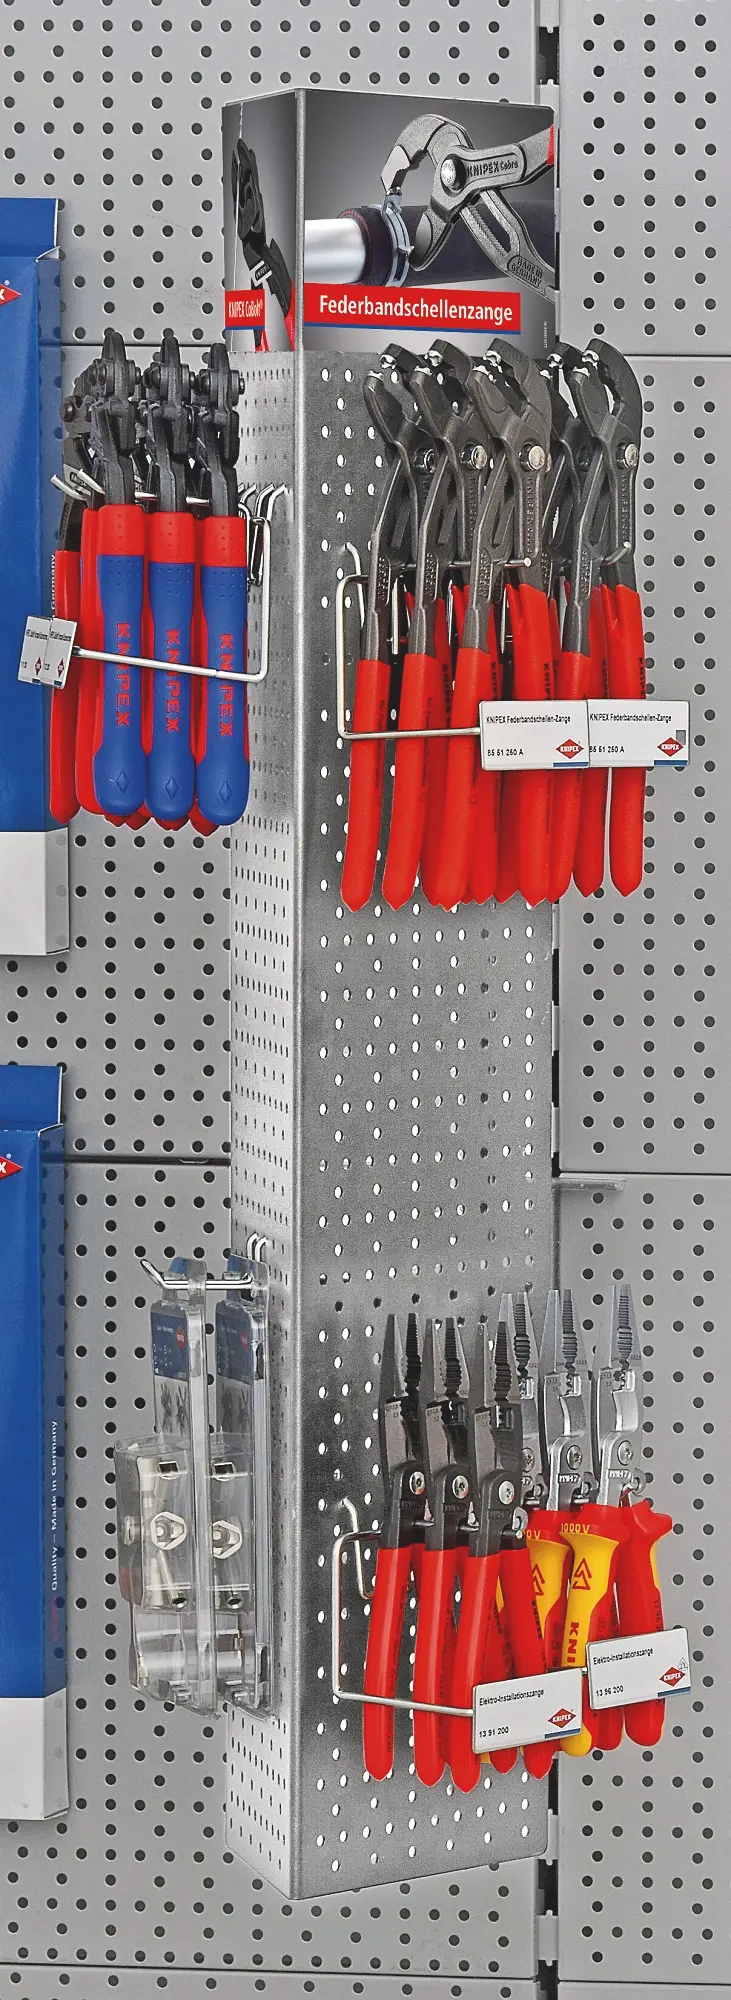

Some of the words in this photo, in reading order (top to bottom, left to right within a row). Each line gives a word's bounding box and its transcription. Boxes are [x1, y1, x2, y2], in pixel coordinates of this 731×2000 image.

[467, 160, 499, 177] KNIPEX
[500, 160, 519, 171] Cobra
[228, 300, 245, 318] KNIPEX
[319, 294, 513, 325] Federbandschellenzange
[117, 622, 130, 727] KNIPEX
[167, 629, 180, 732] KNIPEX
[220, 633, 233, 737] KNPEX
[486, 716, 506, 724] KNIPEX
[507, 714, 571, 724] Federbandschellen-Zange
[590, 713, 609, 721] KNIPEX
[610, 713, 671, 723] Federbandschellen-Zange
[506, 748, 517, 756] 250
[518, 748, 524, 756] A
[560, 745, 579, 753] KNIPEX
[51, 1480, 57, 1491] in
[560, 1523, 581, 1533] 1000
[582, 1524, 590, 1534] V
[567, 1622, 579, 1663] KNI
[593, 1647, 654, 1665] Elektro-Installationszange
[663, 1672, 682, 1682] KNIPEX
[596, 1689, 603, 1697] 13
[604, 1687, 612, 1695] 96
[613, 1685, 624, 1693] 200
[479, 1689, 545, 1706] Elektro-Installationszange
[552, 1713, 572, 1722] KNIPEX
[479, 1730, 487, 1738] 13
[488, 1728, 496, 1736] 91
[497, 1726, 509, 1735] 200
